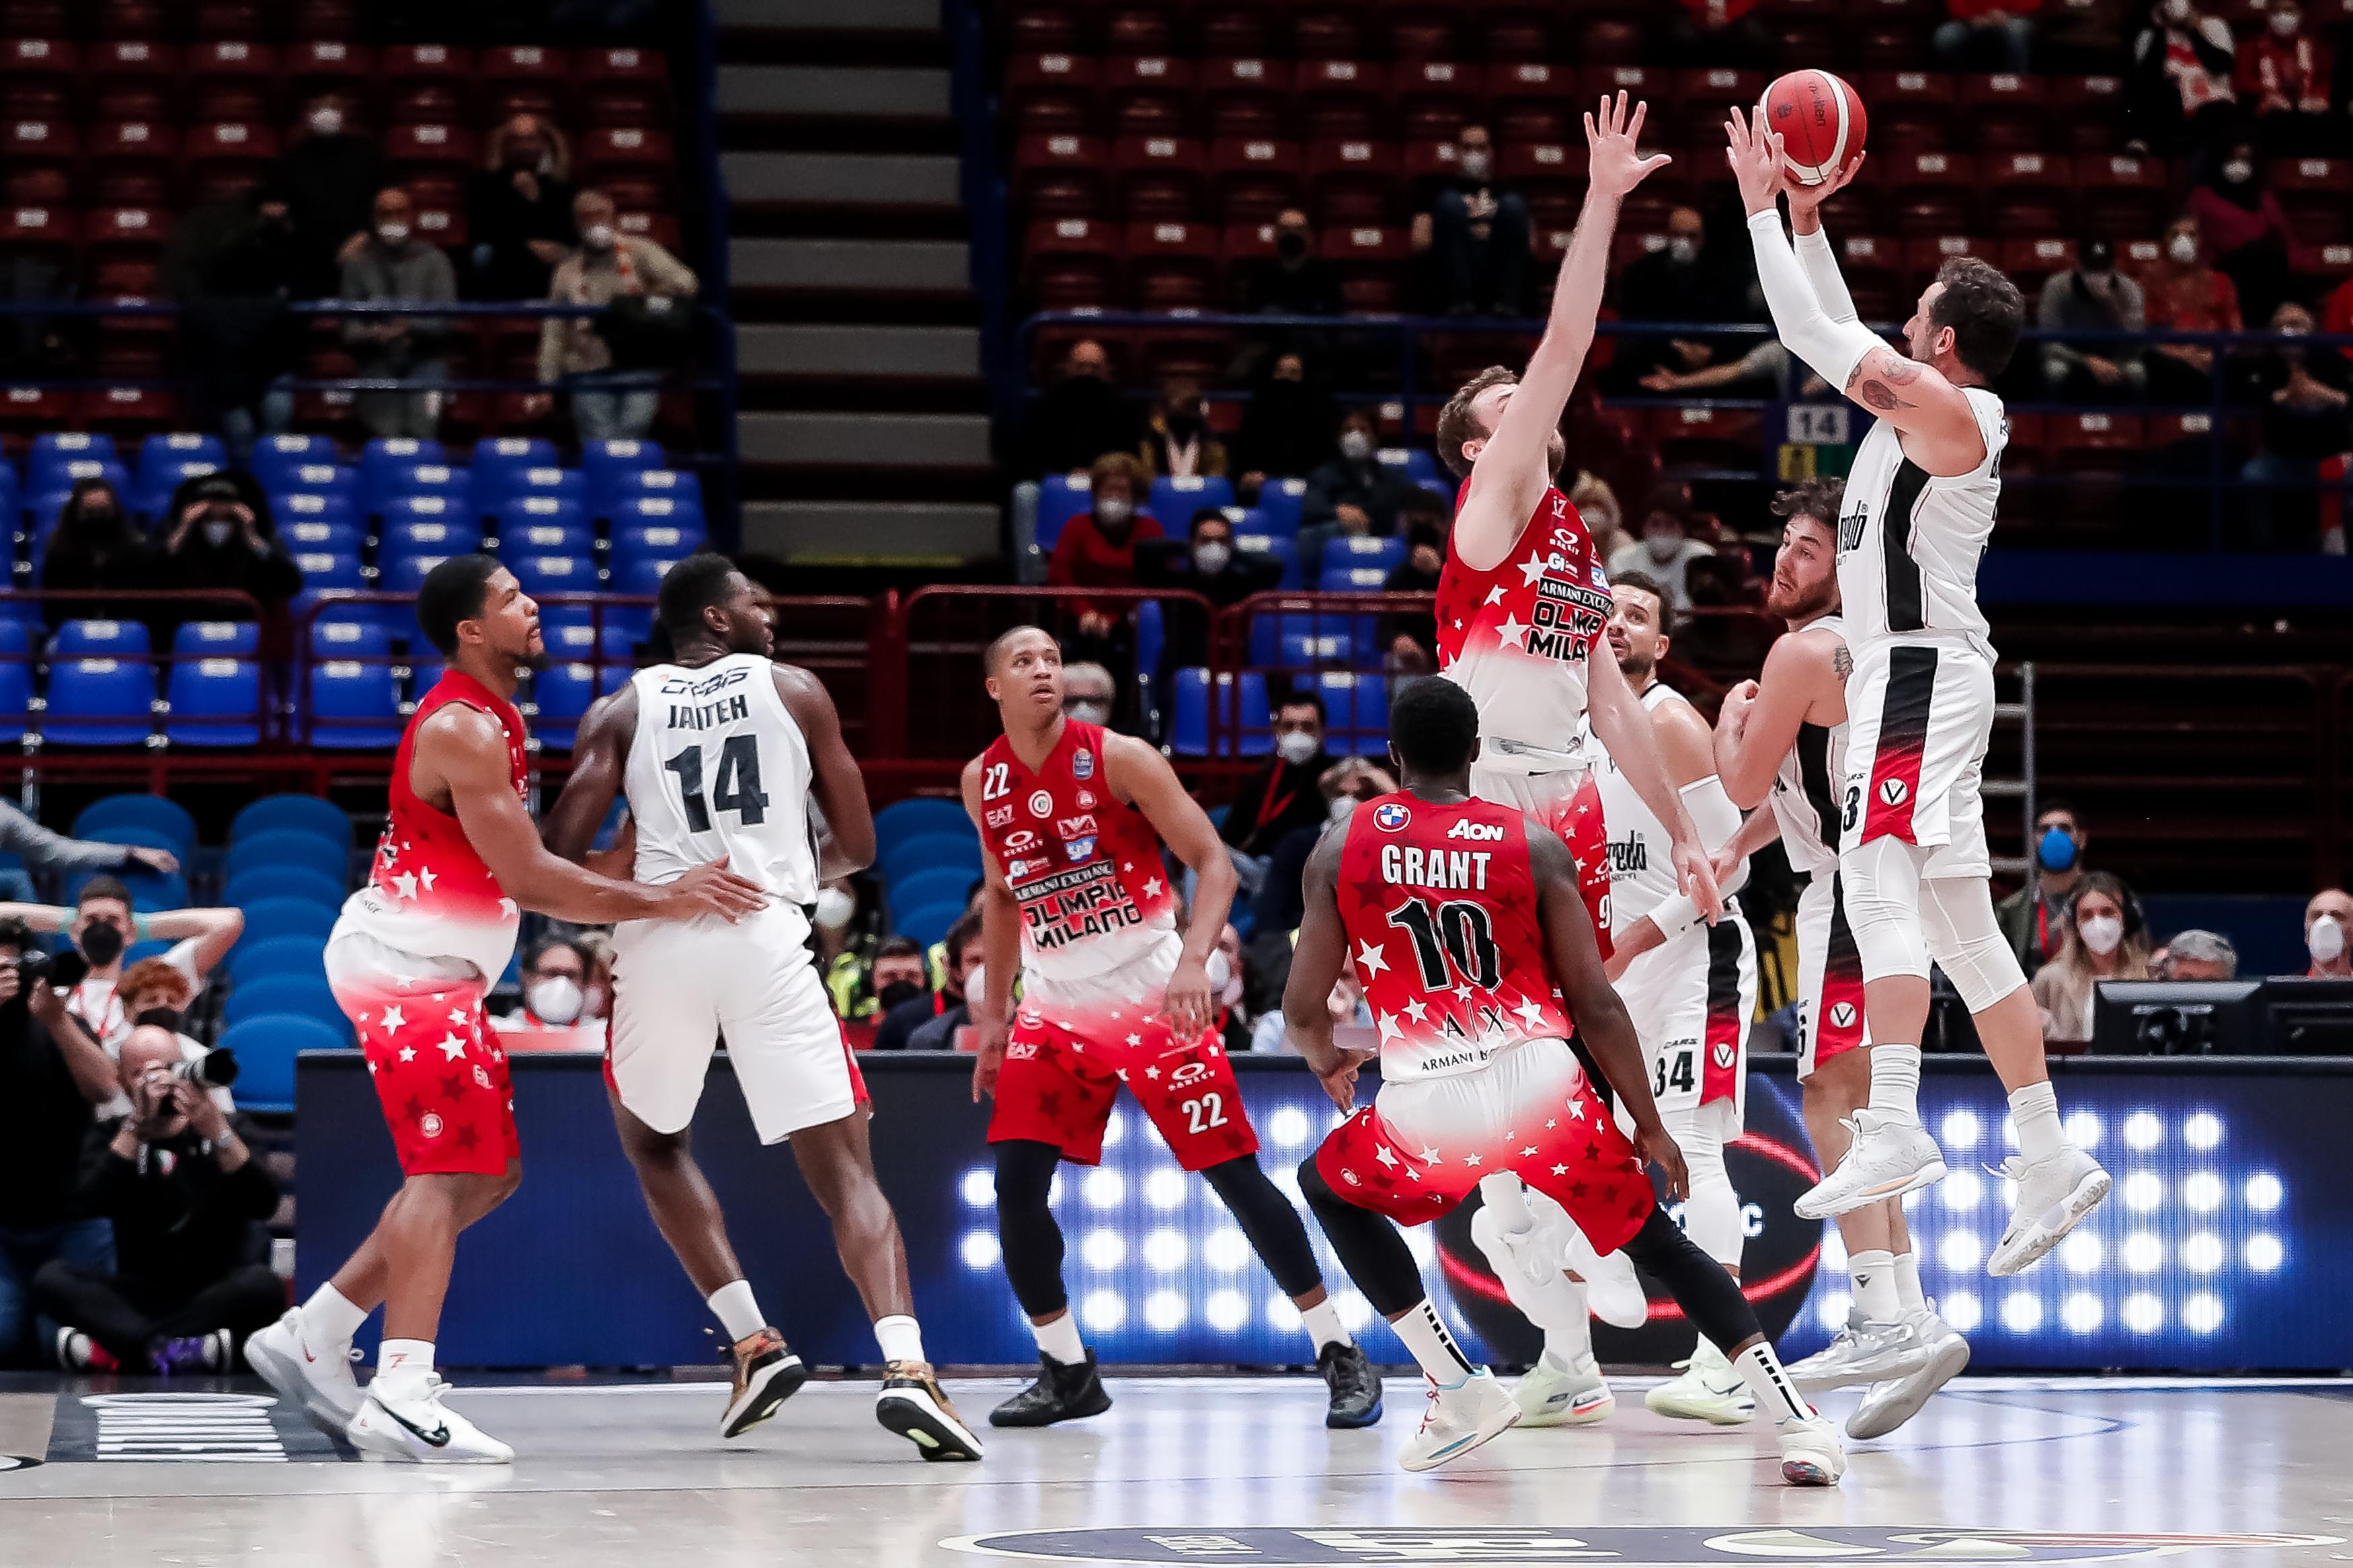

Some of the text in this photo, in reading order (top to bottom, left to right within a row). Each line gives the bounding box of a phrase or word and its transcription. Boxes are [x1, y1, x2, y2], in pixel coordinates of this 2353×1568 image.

[1799, 411, 1838, 438] 14
[1527, 630, 1589, 661] MILA
[668, 694, 749, 731] JAITEH
[664, 733, 769, 833] 14
[984, 762, 1010, 801] 22
[1380, 844, 1492, 891] GRANT
[1386, 897, 1503, 993] 10
[1421, 1052, 1474, 1071] ARMANI
[1654, 1050, 1696, 1098] 34
[1182, 1092, 1229, 1134] 22
